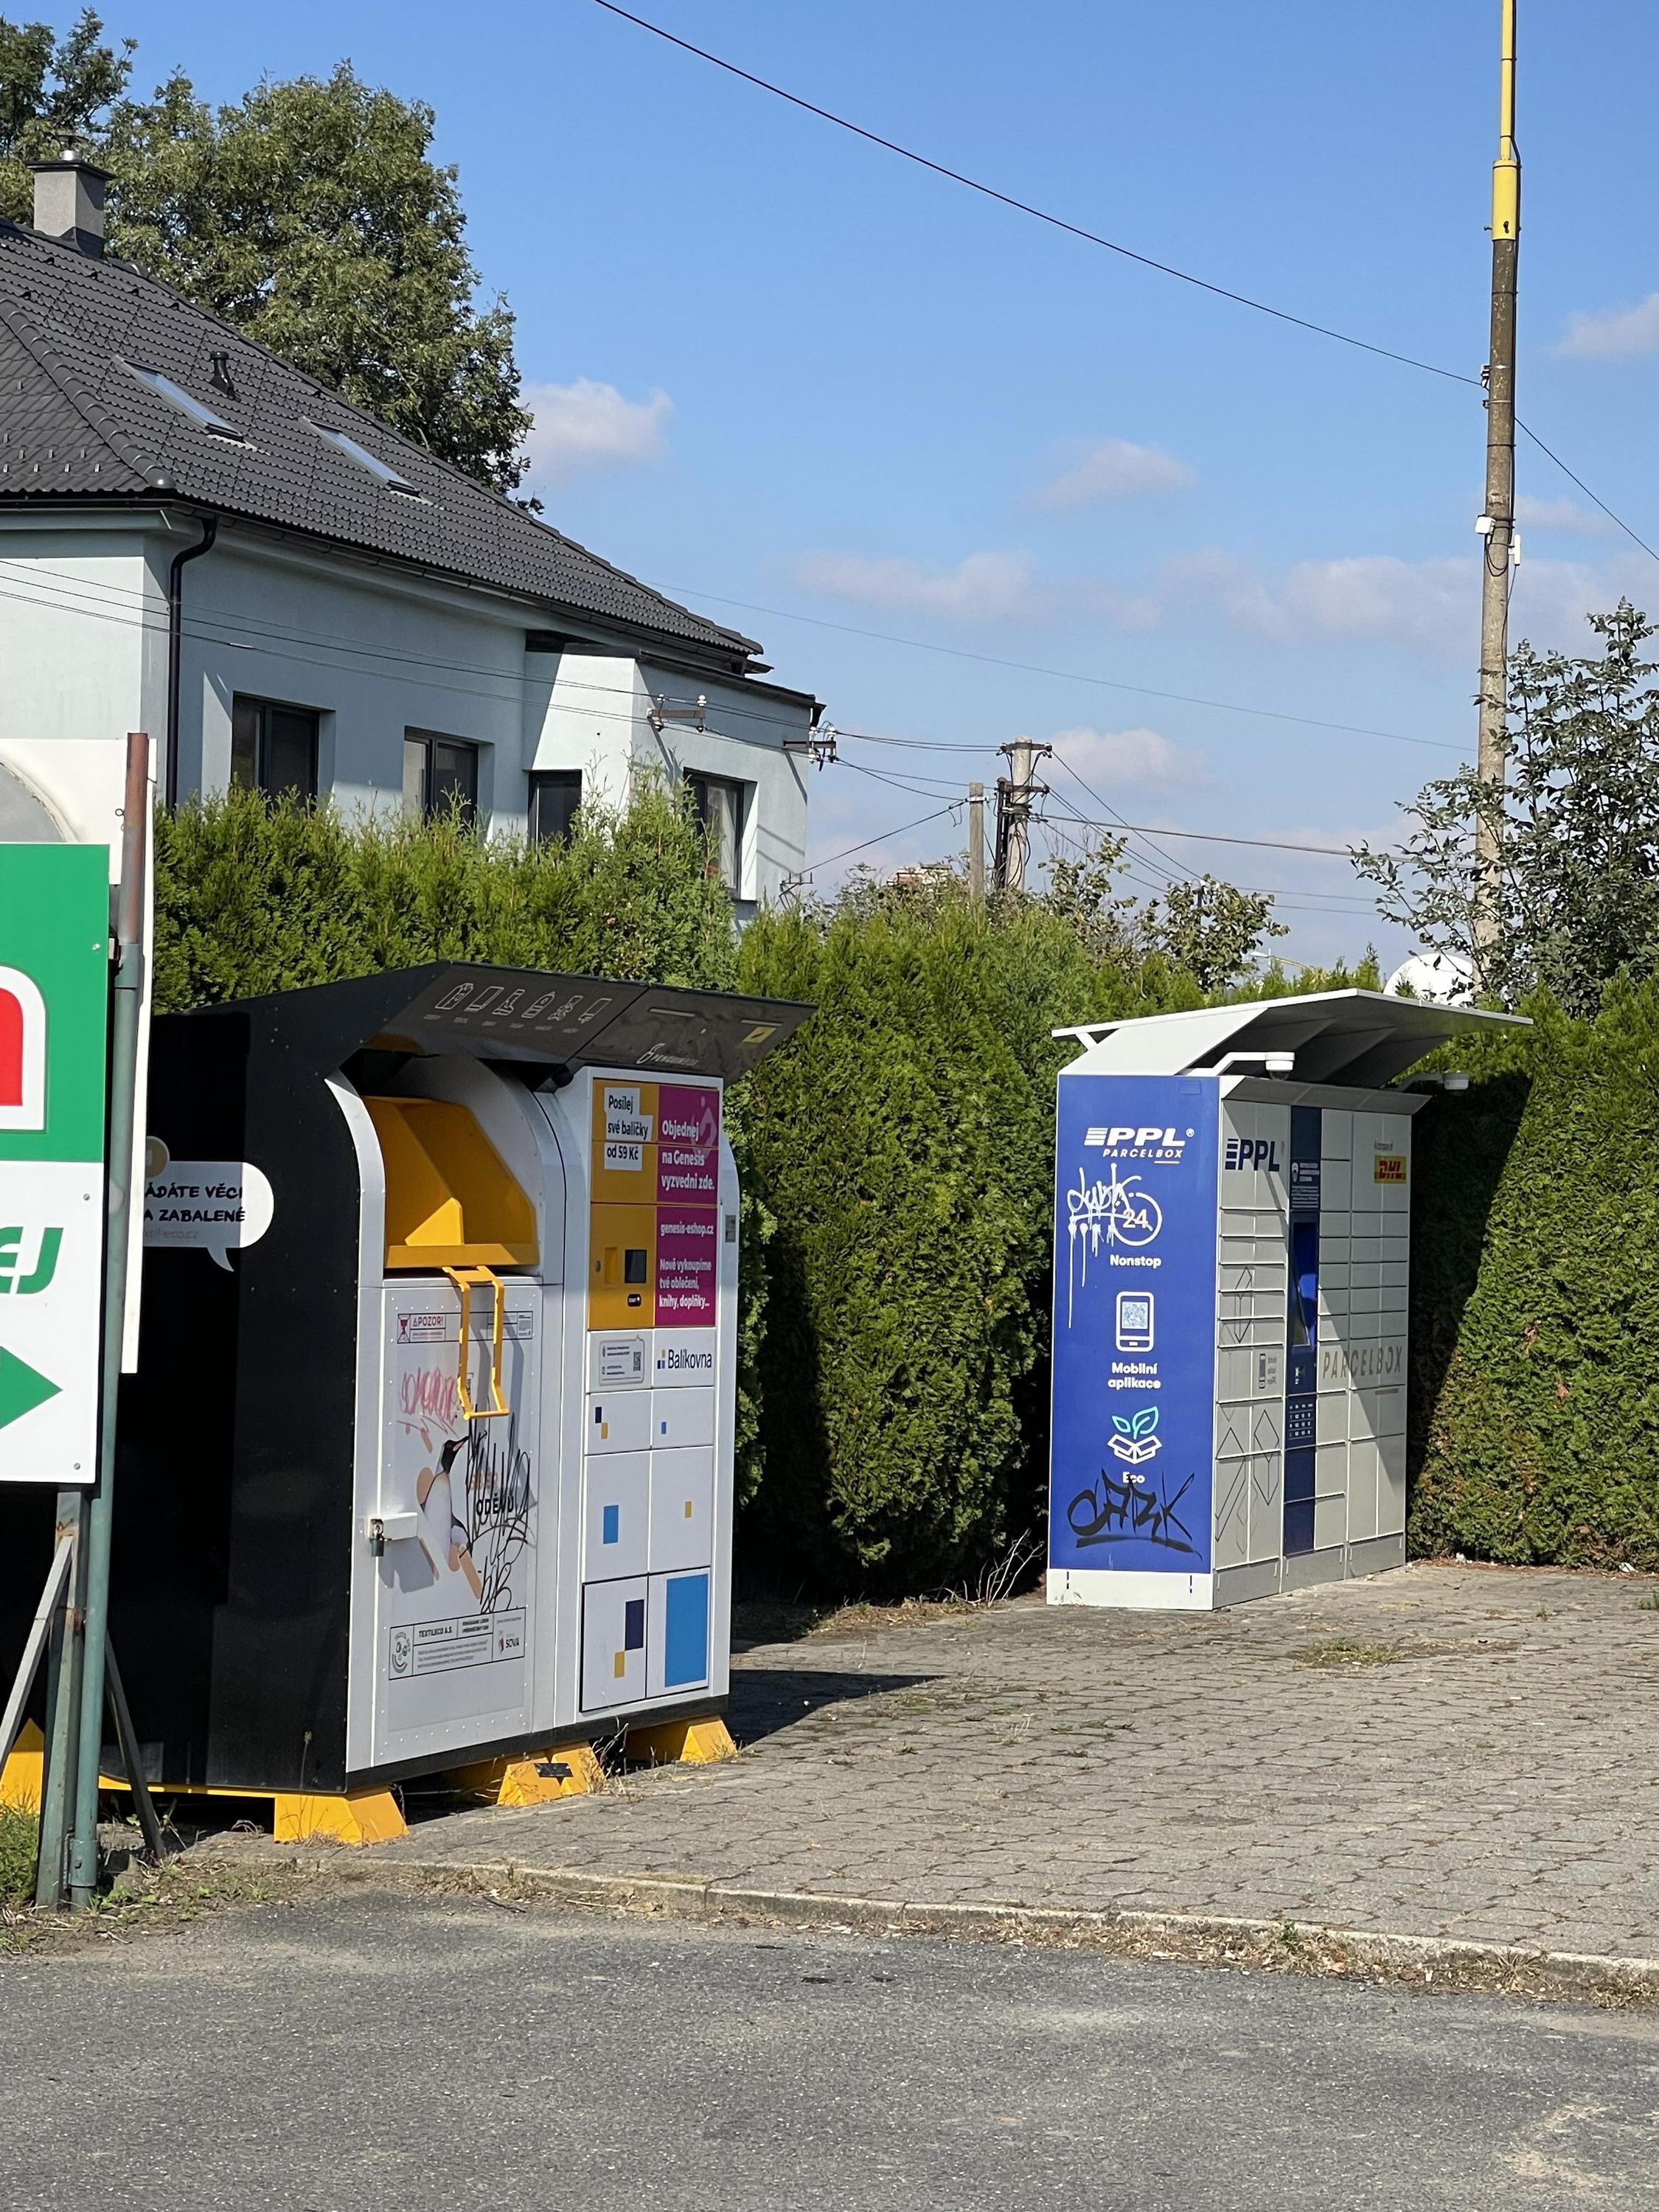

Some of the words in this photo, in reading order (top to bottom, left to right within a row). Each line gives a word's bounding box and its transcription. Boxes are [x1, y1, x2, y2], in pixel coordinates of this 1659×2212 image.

[608, 1095, 633, 1114] Posílej
[608, 1119, 620, 1134] své
[622, 1121, 648, 1140] balíčky
[661, 1120, 699, 1141] Objednej
[607, 1146, 616, 1158] od
[618, 1146, 627, 1160] 59
[629, 1147, 639, 1161] Kč
[661, 1151, 672, 1164] na
[673, 1150, 705, 1166] Genesis
[1103, 1149, 1183, 1158] PARCELBOX
[661, 1173, 698, 1191] vyzvedni
[698, 1175, 715, 1190] zde.
[205, 1183, 243, 1199] VĚCI
[159, 1206, 246, 1222] ZABALENÉ
[1122, 1208, 1147, 1228] 24
[660, 1221, 714, 1237] genesis-eshop.cz
[1110, 1255, 1162, 1268] Nonstop
[659, 1276, 670, 1289] tvé
[671, 1276, 699, 1290] oblečení,
[659, 1294, 679, 1310] knihy,
[418, 1316, 444, 1326] POZOR!
[667, 1349, 712, 1369] Balíkovna
[1323, 1346, 1402, 1380] PARCELBOX
[1112, 1362, 1158, 1374] Mobilní
[1107, 1377, 1161, 1391] aplikace
[1123, 1472, 1146, 1484] Eco
